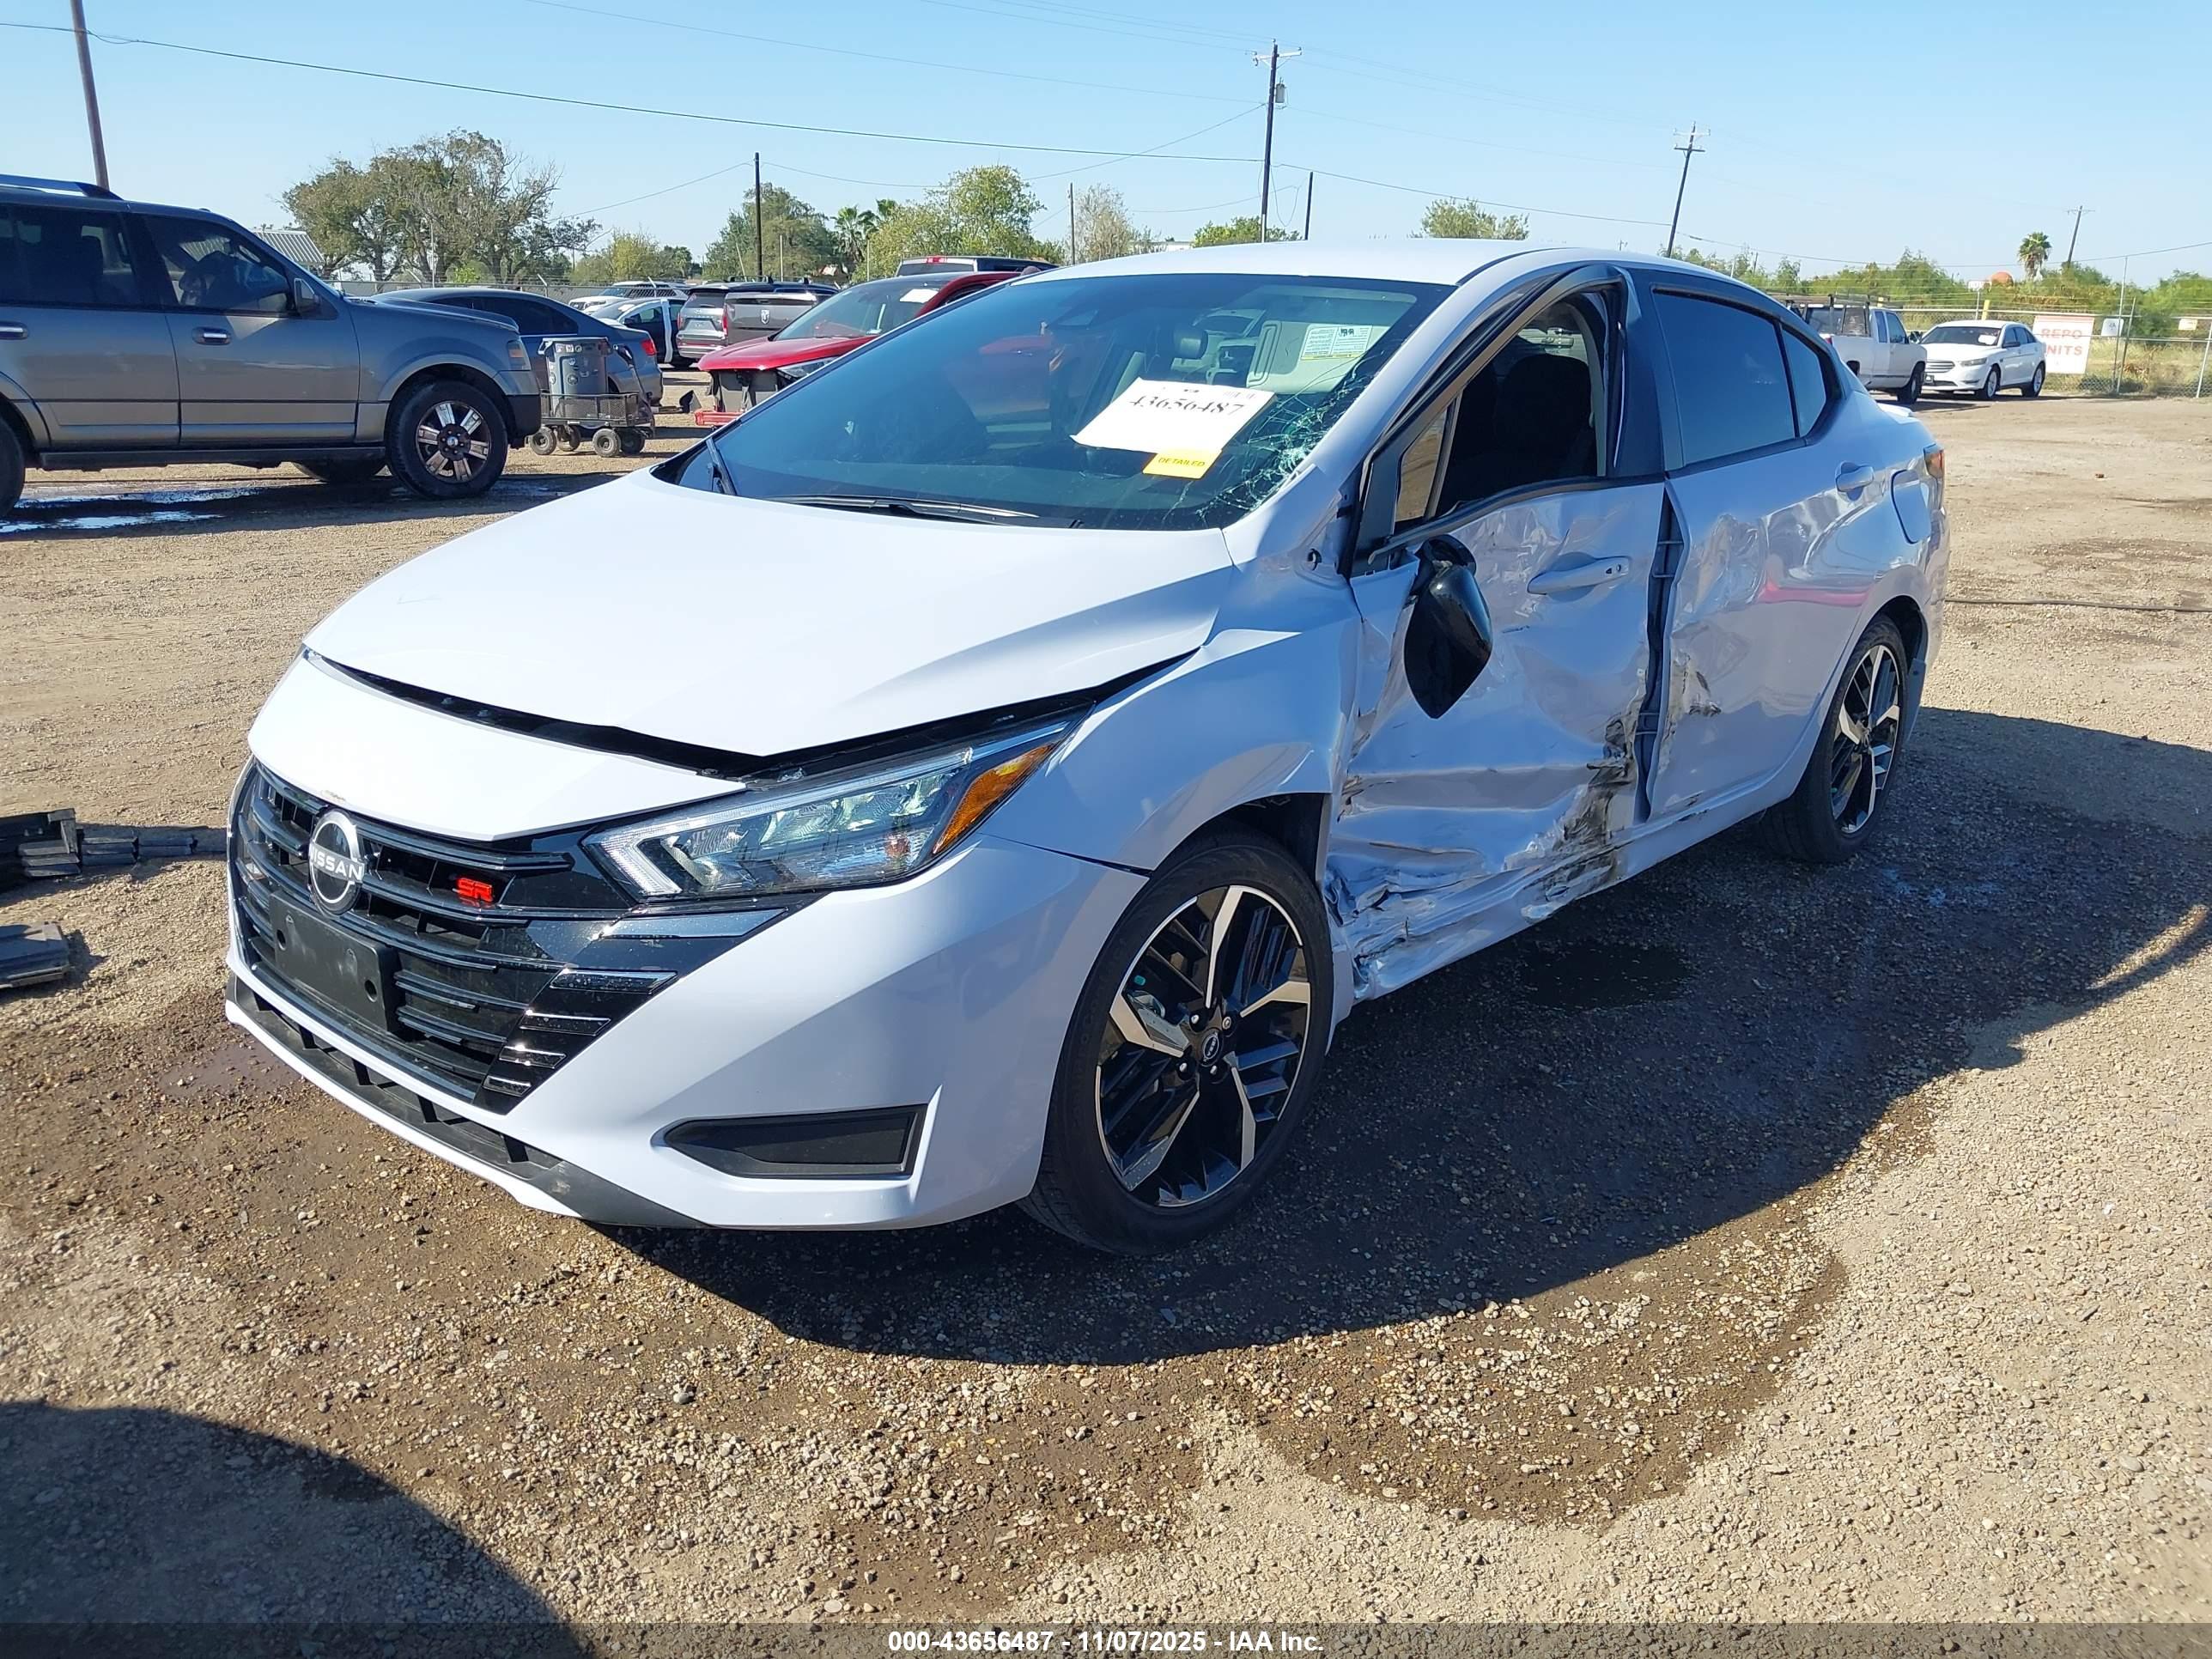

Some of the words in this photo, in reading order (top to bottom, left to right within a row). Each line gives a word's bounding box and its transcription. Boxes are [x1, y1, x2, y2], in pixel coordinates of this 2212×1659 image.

[2040, 328, 2082, 339] REPO
[2045, 344, 2082, 356] NITS
[1158, 457, 1206, 467] DETAILED
[458, 878, 493, 902] SR
